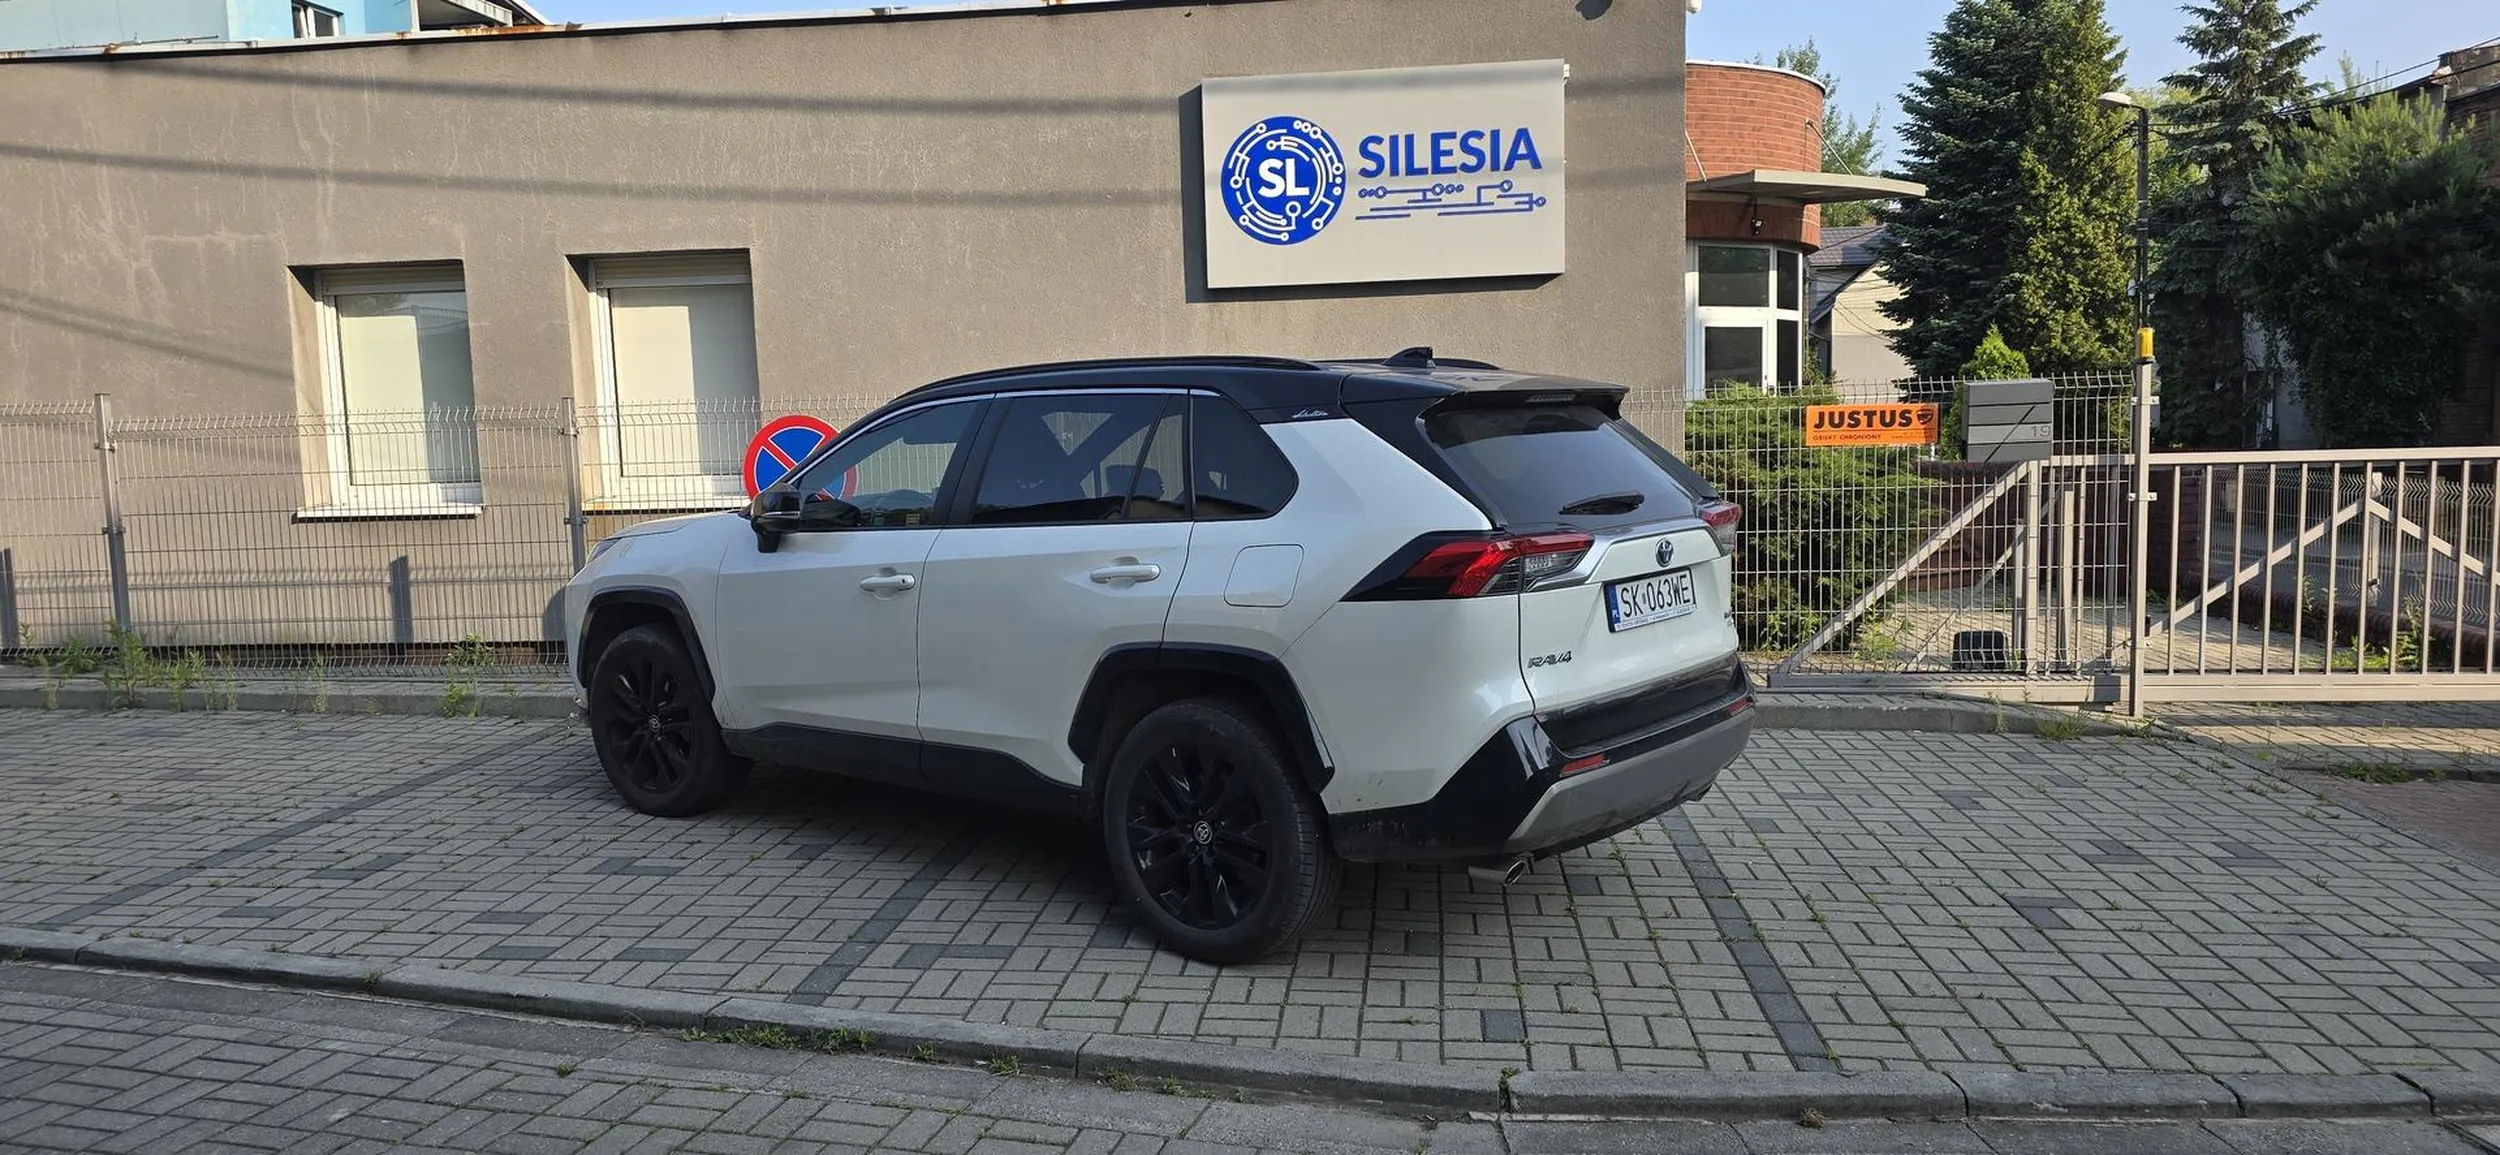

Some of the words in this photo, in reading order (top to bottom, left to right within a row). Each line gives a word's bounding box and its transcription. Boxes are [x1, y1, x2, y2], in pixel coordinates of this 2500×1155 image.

[1358, 127, 1542, 178] SILESIA
[1258, 158, 1310, 198] SL
[1813, 409, 1913, 429] JUSTUS
[2031, 425, 2051, 437] 19
[1620, 584, 1644, 618] SK
[1646, 574, 1691, 611] 063WE
[1528, 650, 1572, 669] RAV4
